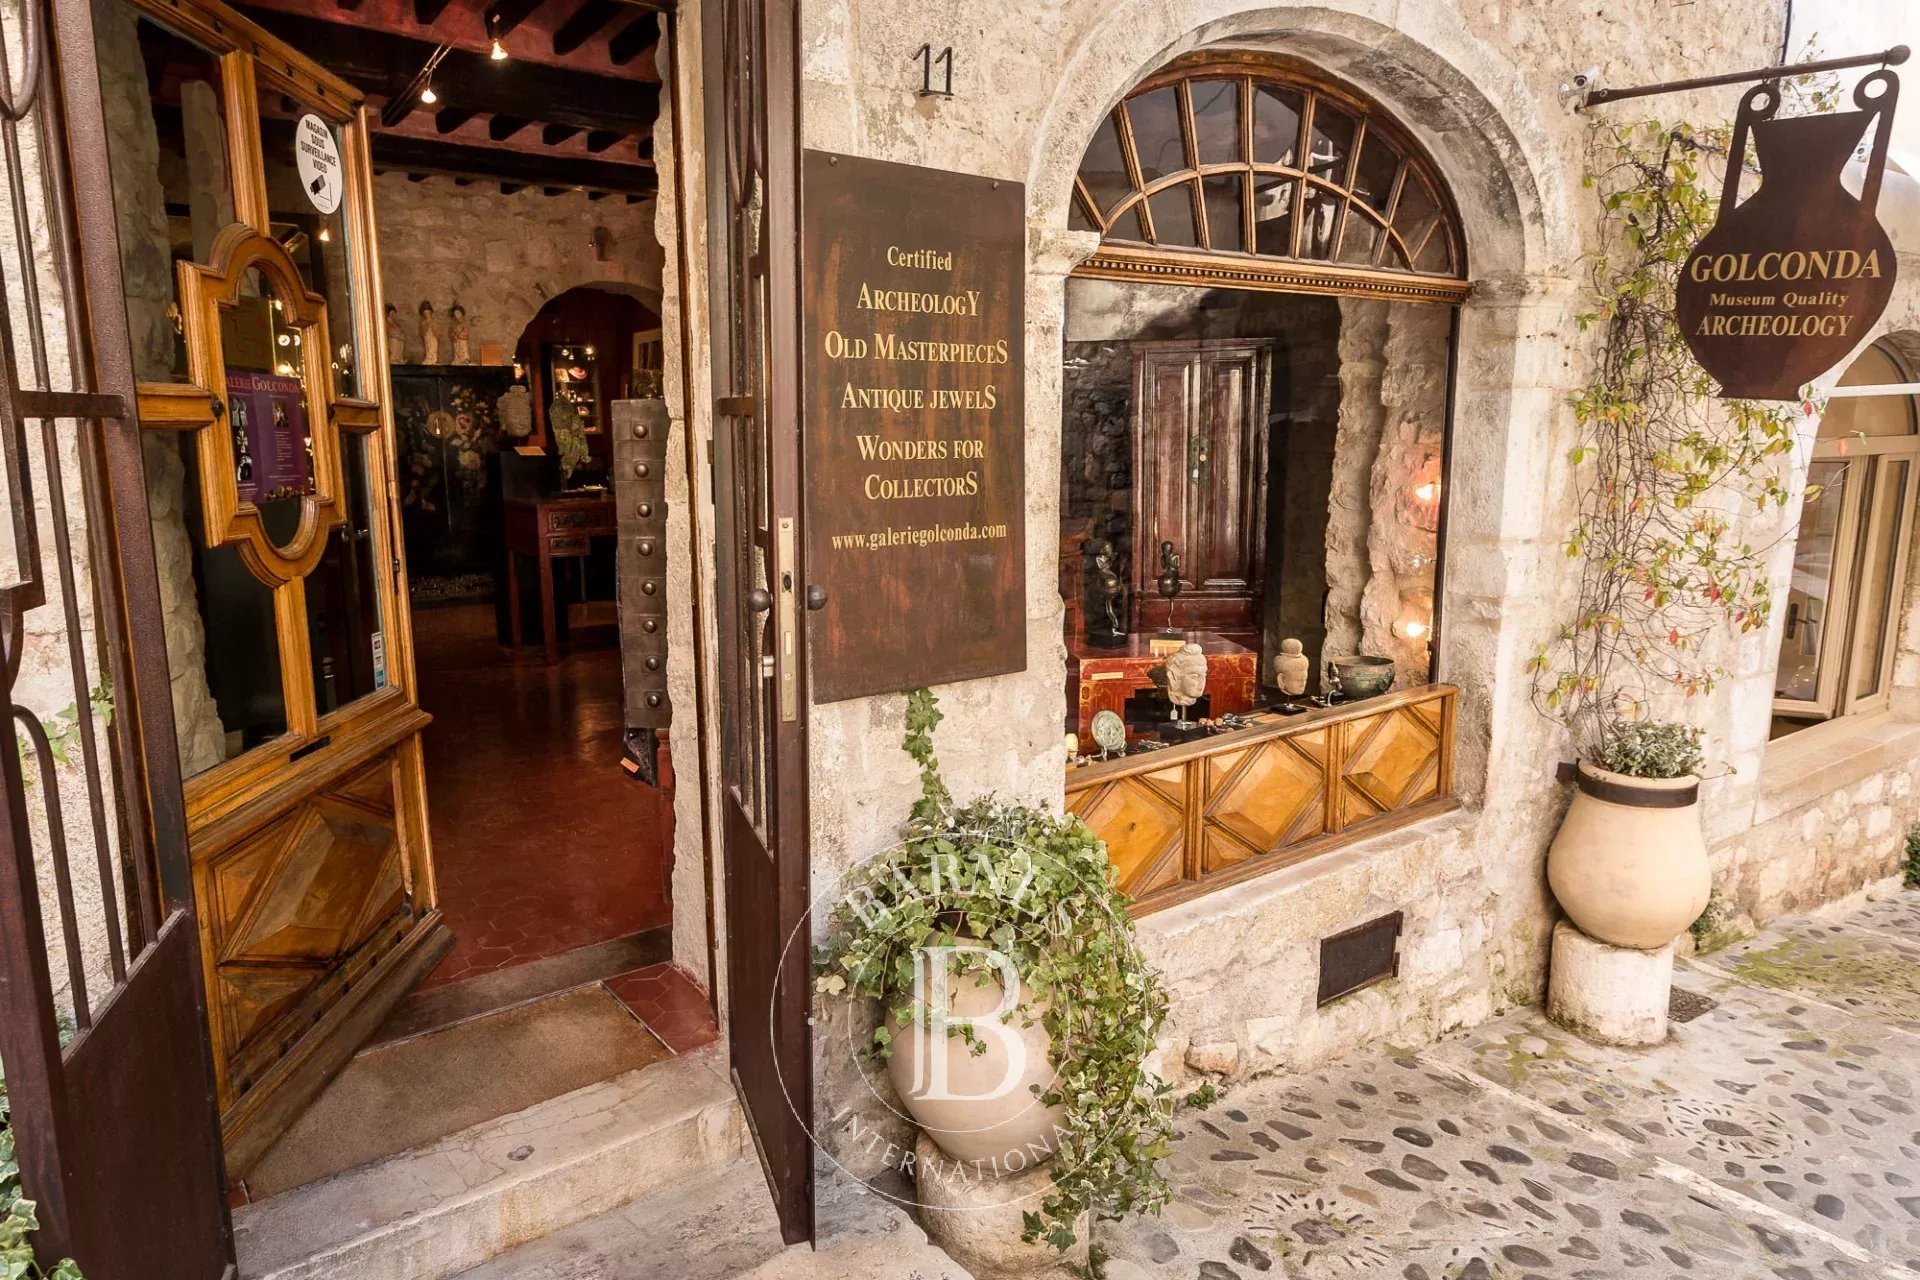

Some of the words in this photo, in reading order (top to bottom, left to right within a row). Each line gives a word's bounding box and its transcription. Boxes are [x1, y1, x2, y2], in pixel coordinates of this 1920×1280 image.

[913, 43, 953, 96] 11
[305, 119, 328, 139] MAGASIN
[311, 134, 325, 149] SOUS
[300, 140, 336, 167] SURVEILLANCE
[312, 158, 328, 174] VIDEO
[887, 246, 952, 271] Certified
[1690, 249, 1881, 282] GOLCONDA
[857, 282, 980, 316] ARCHEOLOGY
[1709, 293, 1775, 306] Museum
[1783, 291, 1850, 307] Quality
[1696, 315, 1854, 337] ARCHEOLOGY
[825, 331, 867, 359] OLD
[874, 333, 1008, 364] MASTERPIECES
[841, 382, 924, 412] ANTIQUE
[930, 385, 997, 410] JEWELS
[856, 435, 947, 461] WONDERS
[953, 440, 984, 459] FOR
[864, 471, 978, 500] COLLECTORS
[832, 522, 1007, 550] www.galeriegolconda.com
